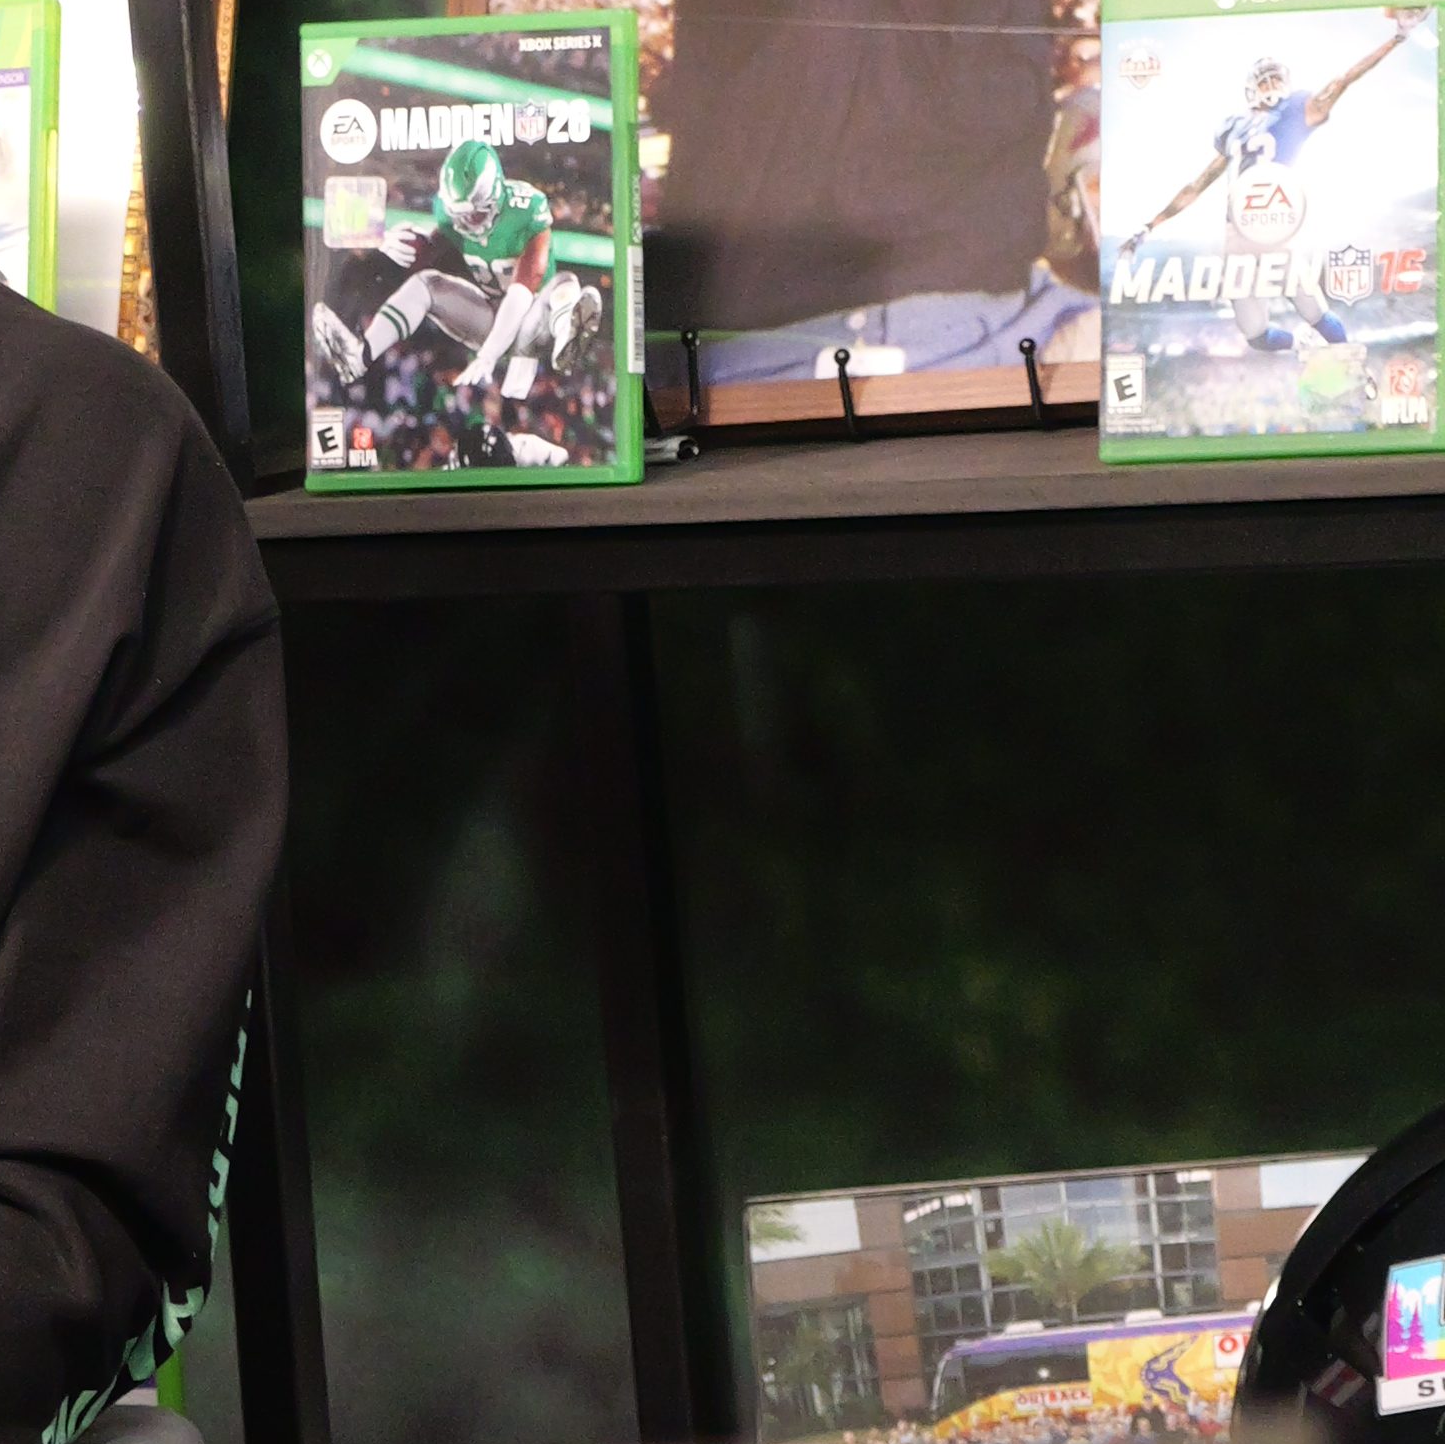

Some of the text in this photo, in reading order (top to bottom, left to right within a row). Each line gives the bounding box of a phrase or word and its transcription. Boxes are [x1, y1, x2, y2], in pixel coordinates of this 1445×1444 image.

[518, 37, 552, 53] XBOX
[553, 35, 591, 51] SERIES
[332, 114, 365, 135] EA
[379, 102, 515, 152] MADDEN
[1242, 182, 1294, 211] EA
[1239, 211, 1297, 228] SPORTS
[1108, 248, 1327, 306] MADDEN
[1331, 266, 1369, 293] NFL
[1112, 373, 1139, 403] E
[316, 426, 339, 454] E
[1016, 1388, 1091, 1407] OUTBACK
